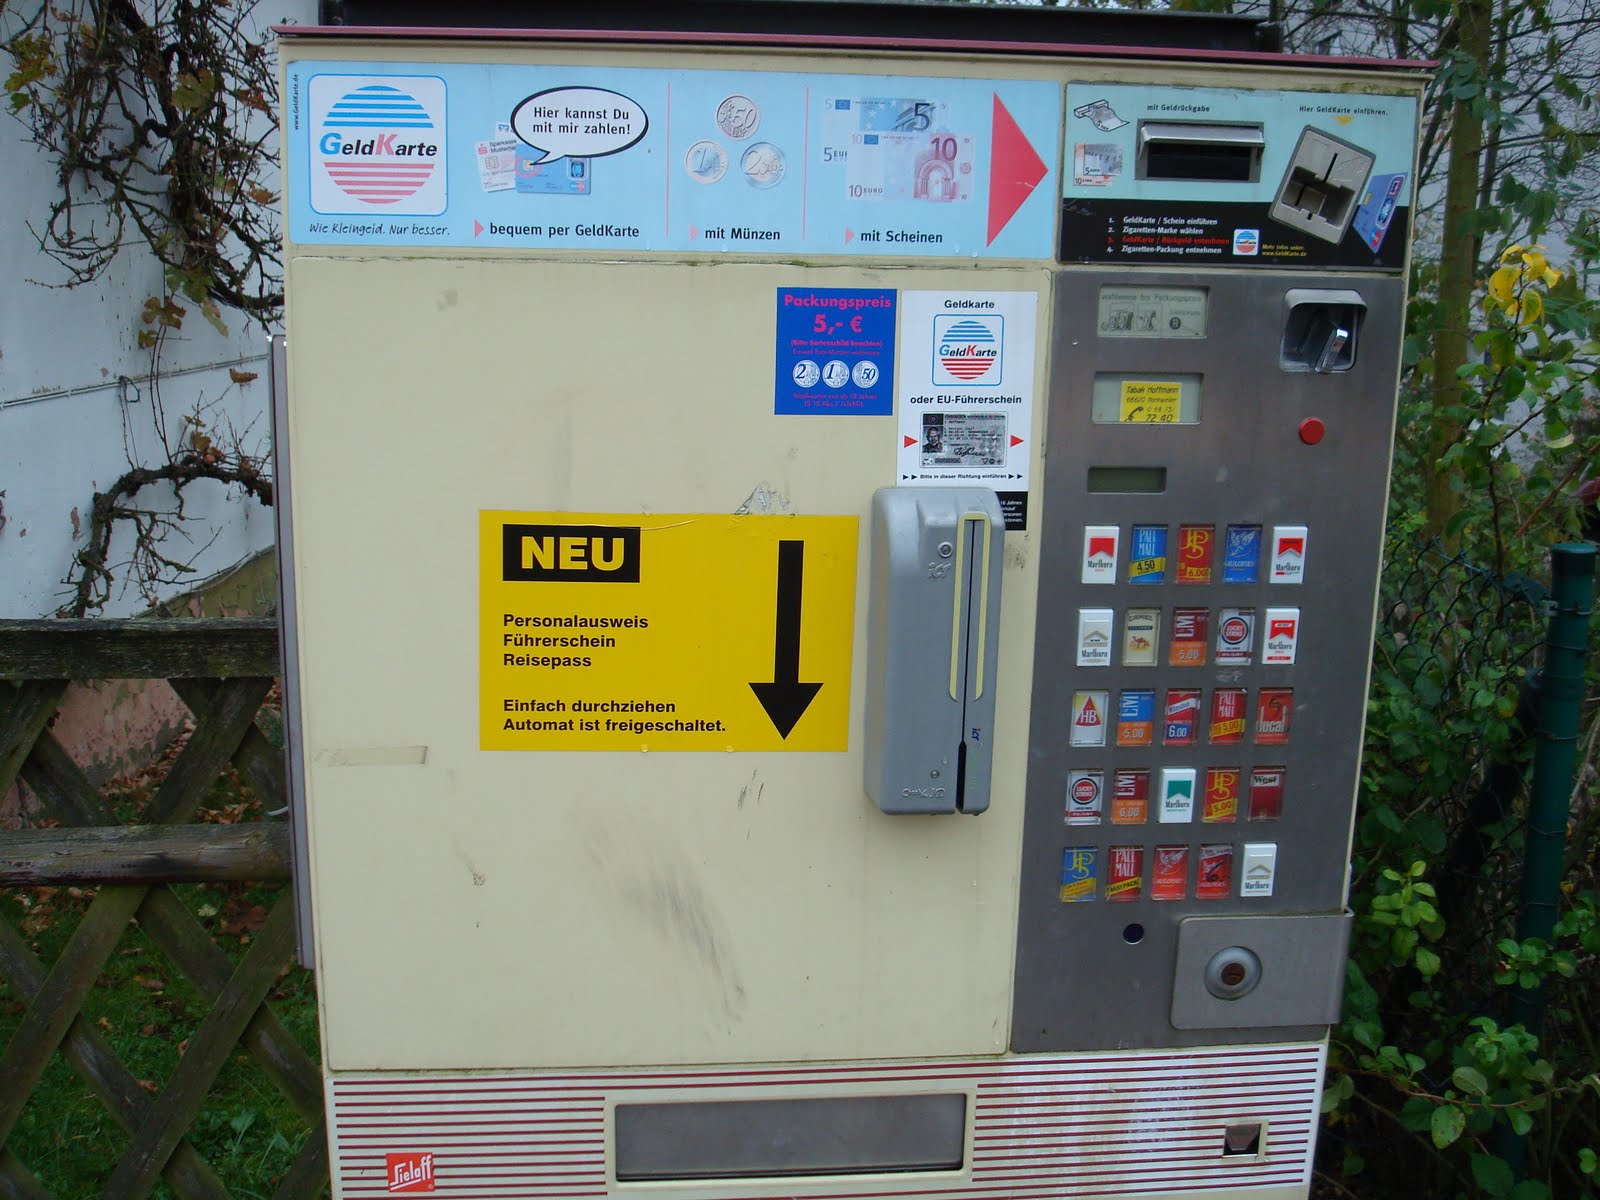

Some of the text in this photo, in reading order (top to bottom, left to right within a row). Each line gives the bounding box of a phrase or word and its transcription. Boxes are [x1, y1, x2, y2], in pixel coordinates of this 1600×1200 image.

[533, 106, 629, 120] Hier kannst Du
[1161, 104, 1210, 113] Geldrückgabe
[1316, 106, 1351, 114] GeldKarte
[1354, 107, 1388, 116] einführen.
[733, 107, 757, 128] 50
[914, 103, 930, 131] 5
[532, 122, 630, 135] mit mir zahlen!
[319, 132, 437, 156] GeldKarte
[931, 137, 957, 161] 10
[823, 147, 832, 162] 5
[849, 185, 862, 197] 10
[1123, 216, 1156, 224] GeldKarte
[1163, 216, 1185, 224] Schein
[1187, 217, 1218, 225] einführen
[309, 222, 328, 234] Wie
[388, 223, 409, 235] Nur
[411, 223, 450, 236] besser.
[490, 222, 640, 238] bequem per GeldKarte
[704, 227, 781, 241] mit Münzen
[1122, 226, 1178, 235] Zigaretten-Marke
[1180, 227, 1204, 235] wählen
[860, 230, 943, 244] mit Scheinen
[1121, 245, 1184, 255] Zigaretten-Packung
[1185, 246, 1222, 254] entnehmen
[784, 294, 891, 310] Packungspreis
[944, 300, 995, 309] Geldkarte
[813, 314, 863, 335] 5,- €
[939, 344, 997, 357] GeldKarte
[796, 363, 876, 380] 2 1 50
[1127, 385, 1178, 394] Tabak Hoffmann
[910, 394, 1022, 405] oder EU-Führerschein
[1139, 529, 1156, 543] PALL
[1138, 543, 1155, 556] MALL
[1181, 529, 1209, 559] JPS
[521, 536, 625, 571] NEU
[1087, 559, 1113, 568] Marlboro
[1136, 560, 1155, 570] 4.50
[1275, 562, 1300, 571] Marlboro
[503, 614, 649, 629] Personalausweis
[503, 633, 616, 649] Führerschein
[1267, 641, 1293, 650] Marlboro
[1081, 648, 1108, 658] Marlboro
[503, 653, 592, 670] Reisepass
[1219, 692, 1236, 704] PALL
[503, 699, 676, 714] Einfach durchziehen
[1218, 706, 1235, 717] MALL
[1080, 710, 1097, 723] HB
[503, 718, 726, 735] Automat ist freigeschaltet.
[1168, 725, 1187, 738] 6.00
[1207, 768, 1235, 800] JPS
[1254, 775, 1277, 784] West
[1165, 799, 1190, 808] Marlboro
[1115, 848, 1136, 863] PALL
[1064, 848, 1095, 879] JPS
[1114, 863, 1135, 877] MALL
[1122, 880, 1138, 890] PACK
[1244, 881, 1270, 890] Marlboro
[390, 1154, 432, 1187] Sielaff
